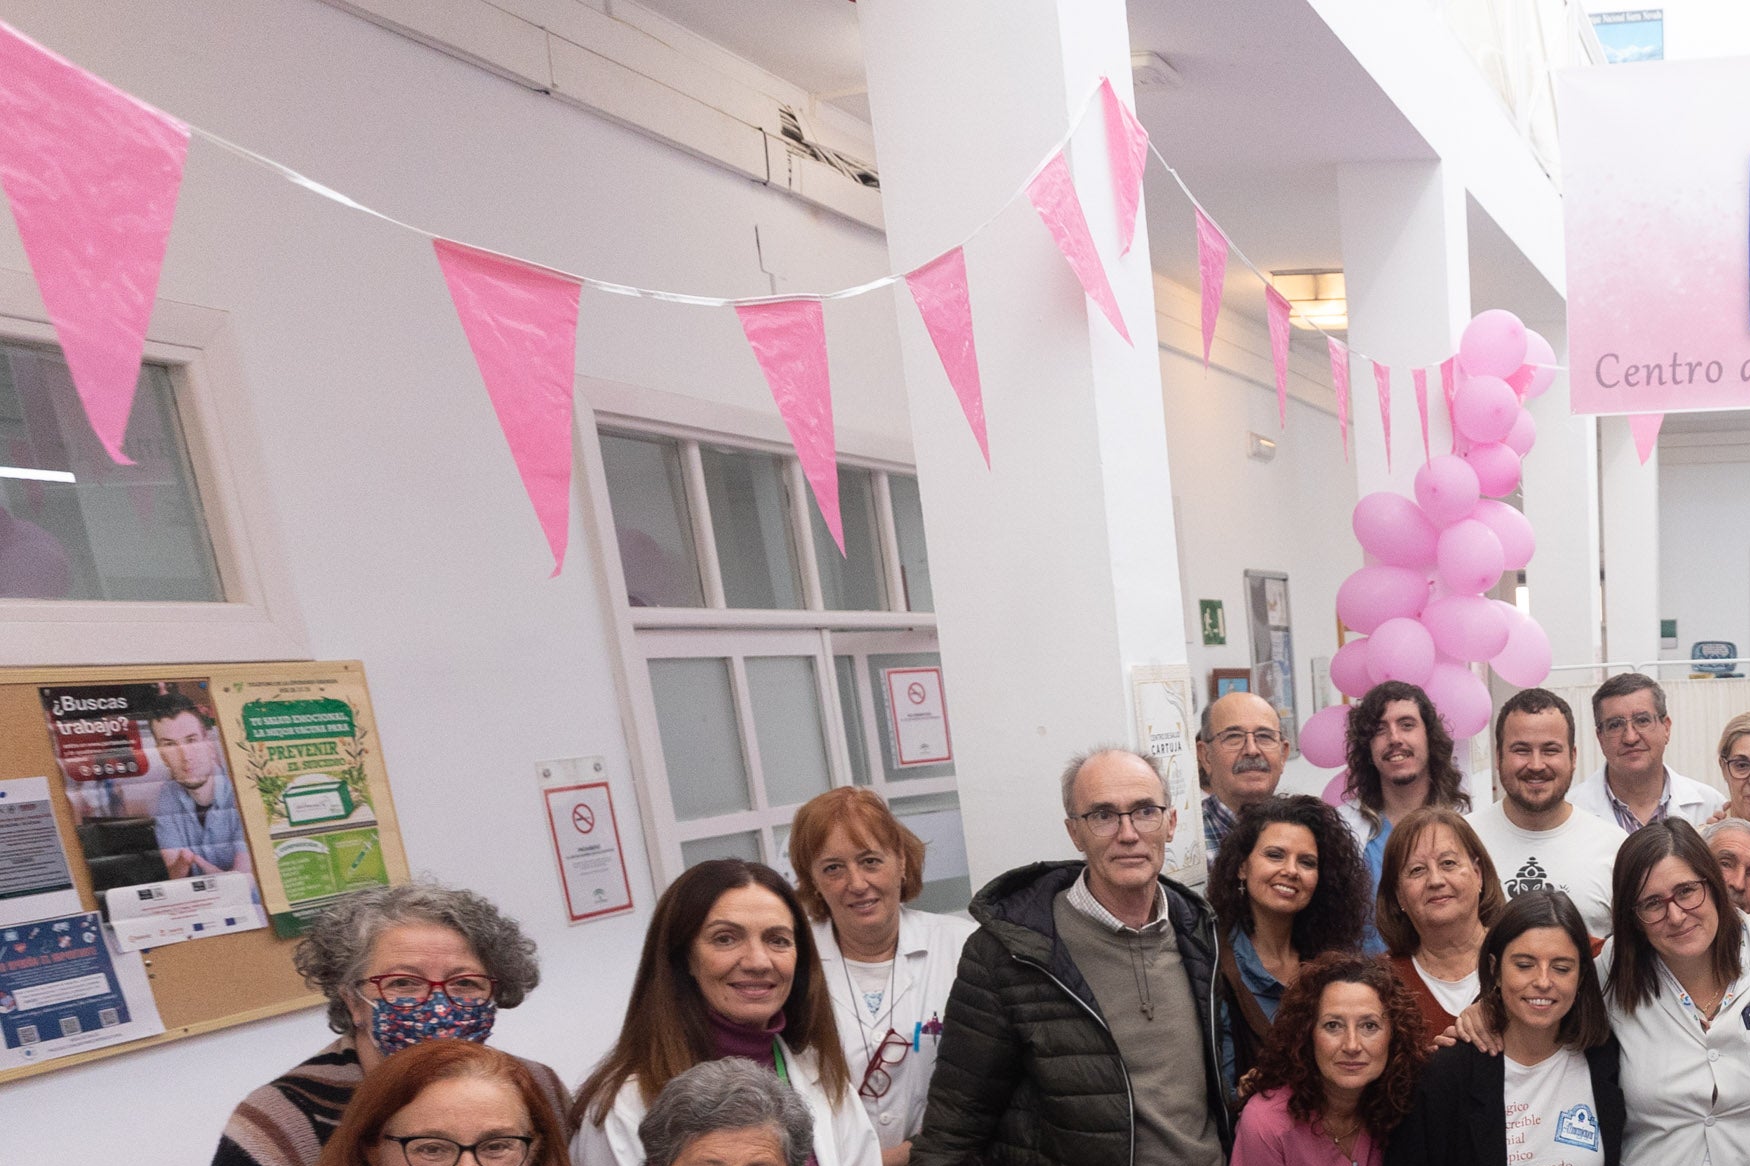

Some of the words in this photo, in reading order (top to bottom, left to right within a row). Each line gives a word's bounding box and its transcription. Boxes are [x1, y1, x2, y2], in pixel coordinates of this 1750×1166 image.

[1595, 352, 1724, 390] Centro
[52, 695, 128, 716] ¿Buscas
[56, 716, 129, 737] trabajo?
[266, 741, 339, 761] PREVENIR
[1151, 741, 1182, 755] CARTUJA
[1506, 1101, 1530, 1116] gico
[1508, 1150, 1534, 1166] pico
